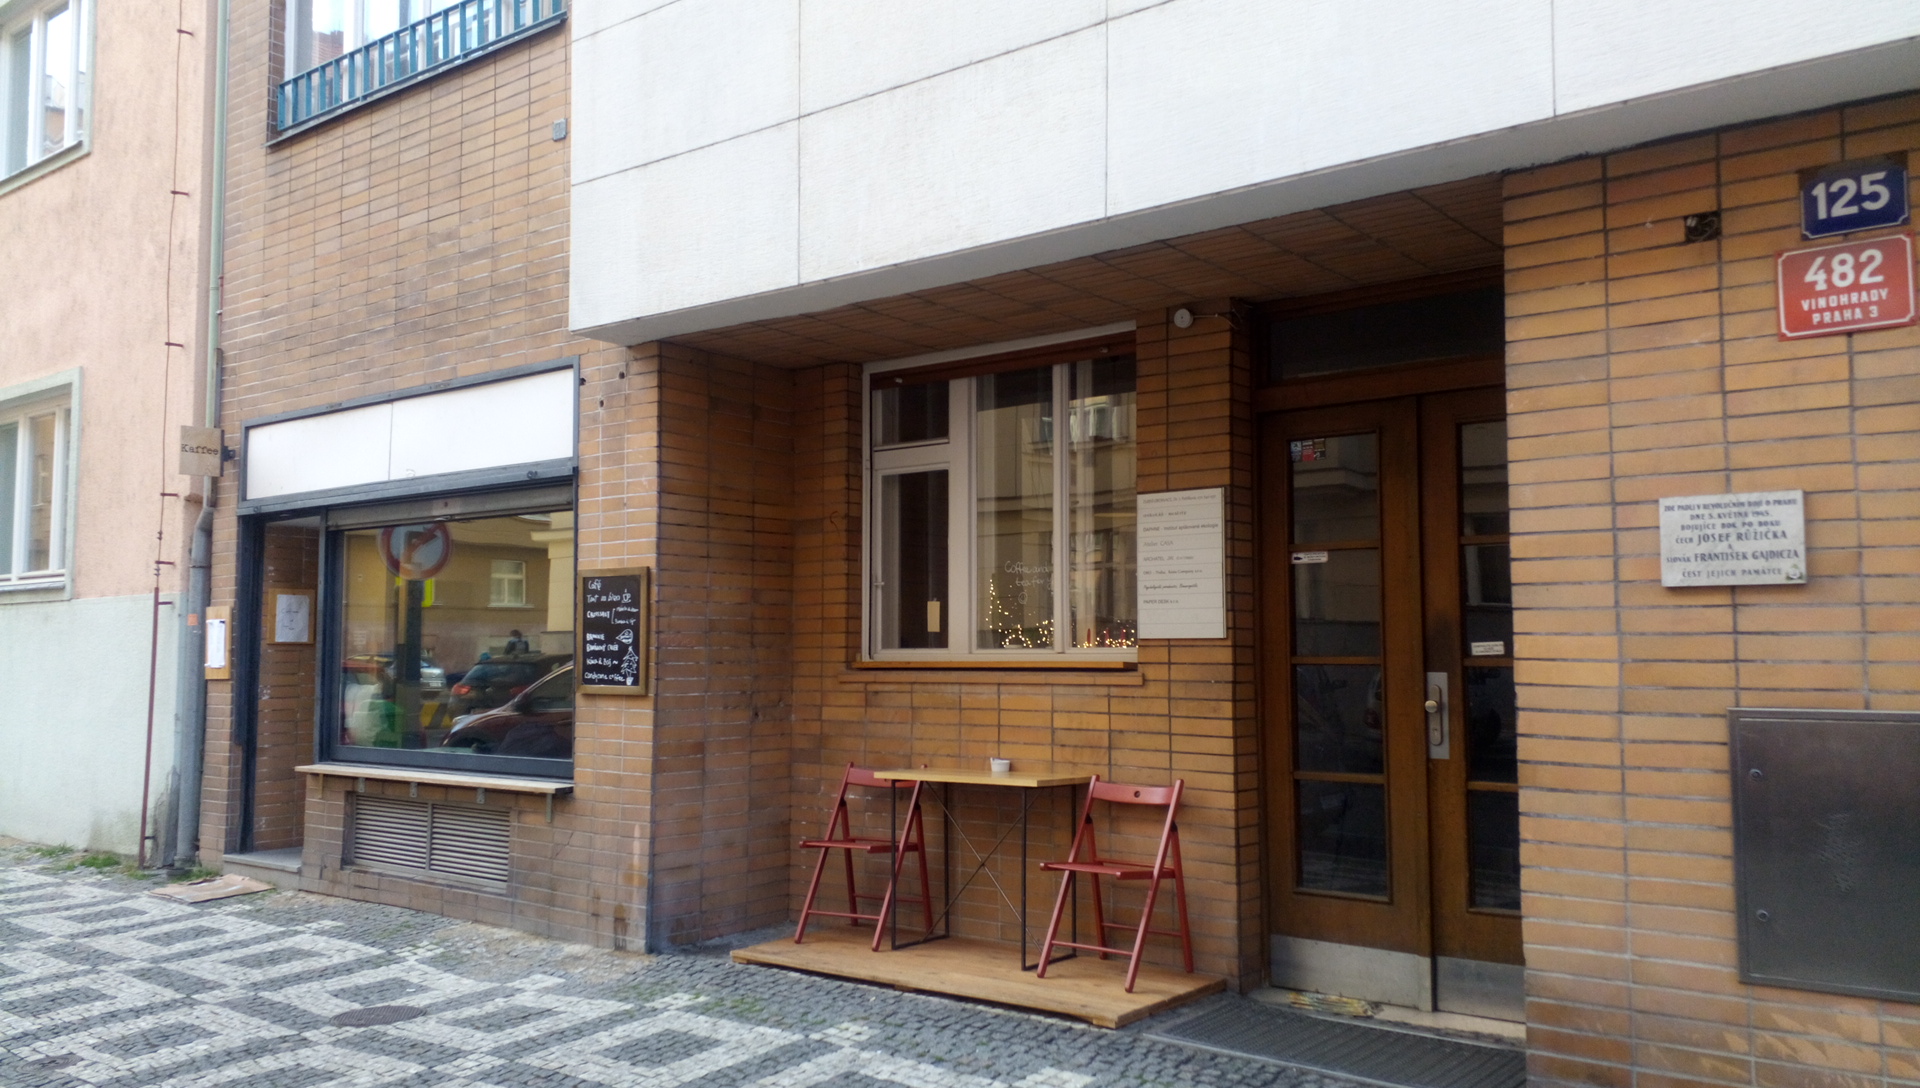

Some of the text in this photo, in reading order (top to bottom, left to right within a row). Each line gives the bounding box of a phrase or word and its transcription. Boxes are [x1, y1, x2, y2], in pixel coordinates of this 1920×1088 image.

[1811, 171, 1890, 220] 125
[1804, 249, 1884, 291] 482
[1801, 288, 1889, 311] VINOHRADY
[1812, 306, 1879, 325] PRAHA 3
[1721, 522, 1737, 530] BOK
[1697, 532, 1731, 546] JOSEF
[1736, 528, 1787, 541] RŮŽIČKA
[1694, 549, 1749, 562] FRANTIŠEK
[1004, 560, 1049, 574] Coffee and
[1682, 567, 1702, 578] ČEST
[1706, 568, 1737, 579] JEJICH
[1015, 577, 1031, 586] tea
[1031, 575, 1044, 588] for
